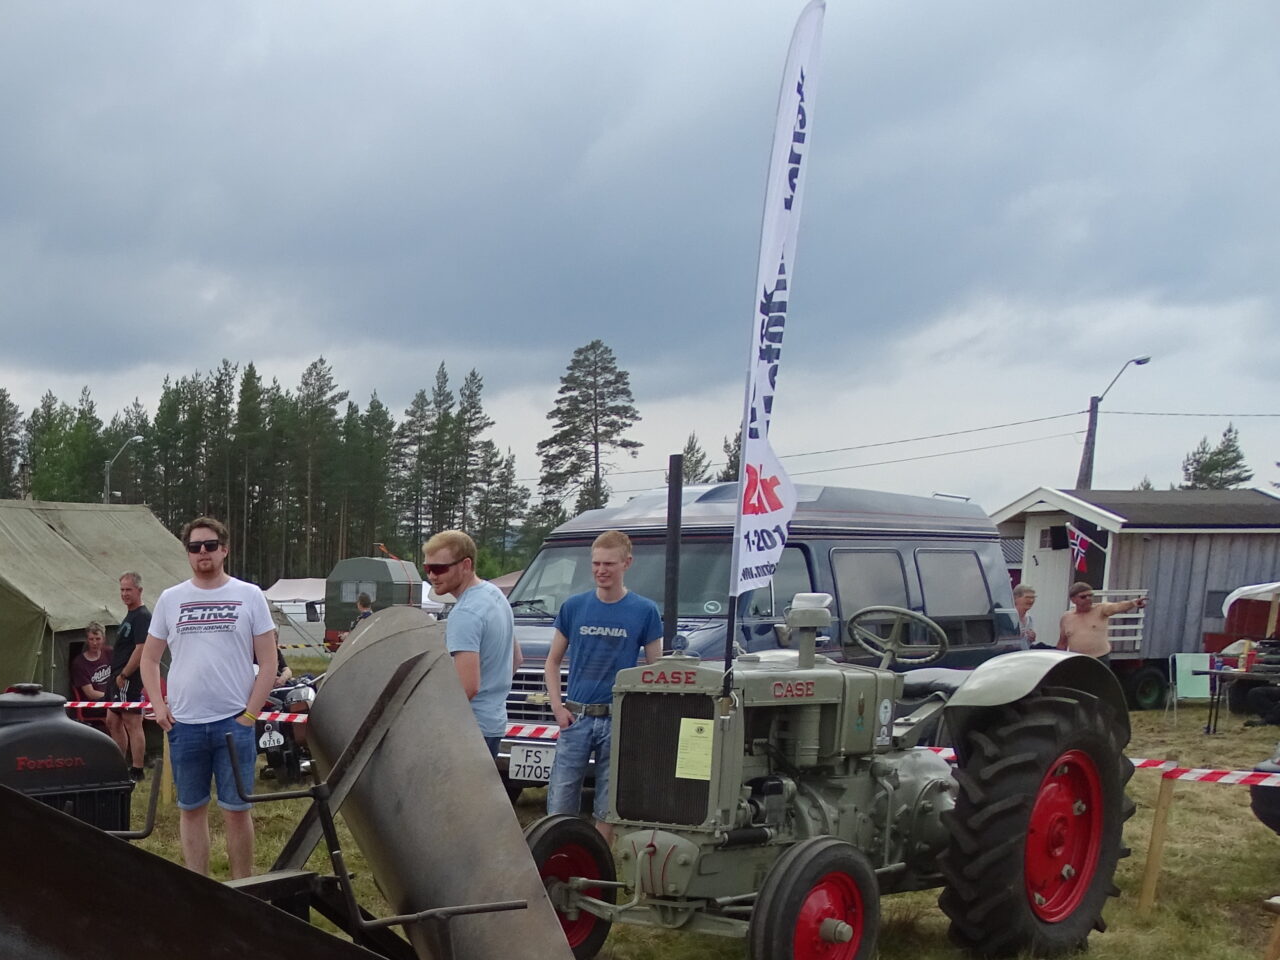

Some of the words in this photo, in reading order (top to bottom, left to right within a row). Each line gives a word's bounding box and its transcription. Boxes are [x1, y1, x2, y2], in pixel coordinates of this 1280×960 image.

[179, 606, 238, 622] PETROL
[580, 625, 627, 638] SCANIA
[641, 671, 697, 685] CASE
[773, 681, 815, 698] CASE
[16, 755, 86, 771] Fordson
[525, 749, 542, 764] FS
[514, 763, 551, 780] 71705
